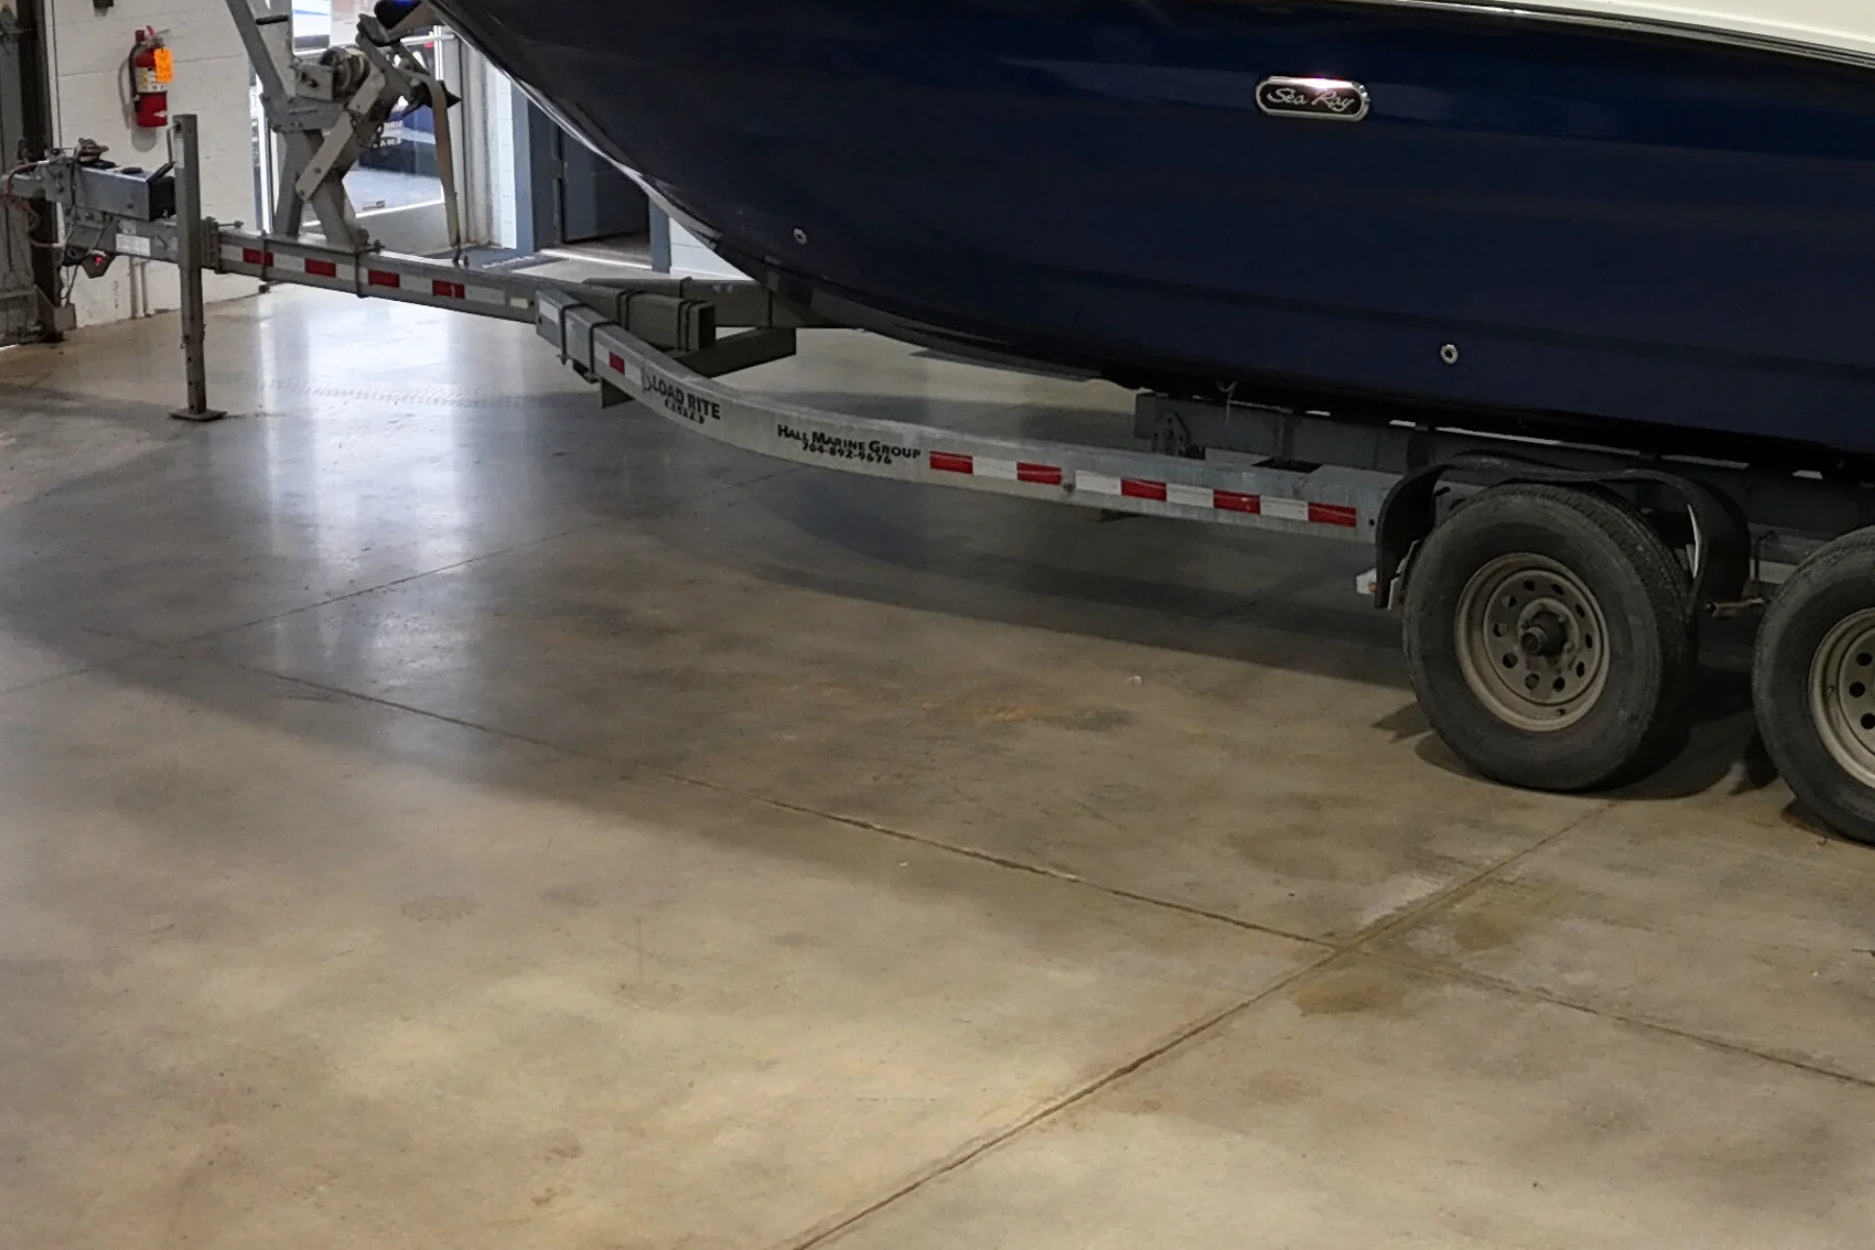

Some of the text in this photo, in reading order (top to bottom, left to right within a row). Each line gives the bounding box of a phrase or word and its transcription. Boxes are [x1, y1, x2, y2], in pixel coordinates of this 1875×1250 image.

[1267, 88, 1354, 112] Sea Ray
[652, 375, 685, 405] LOAD
[687, 393, 721, 420] RITE
[777, 424, 921, 459] HALL MARINE GROUP
